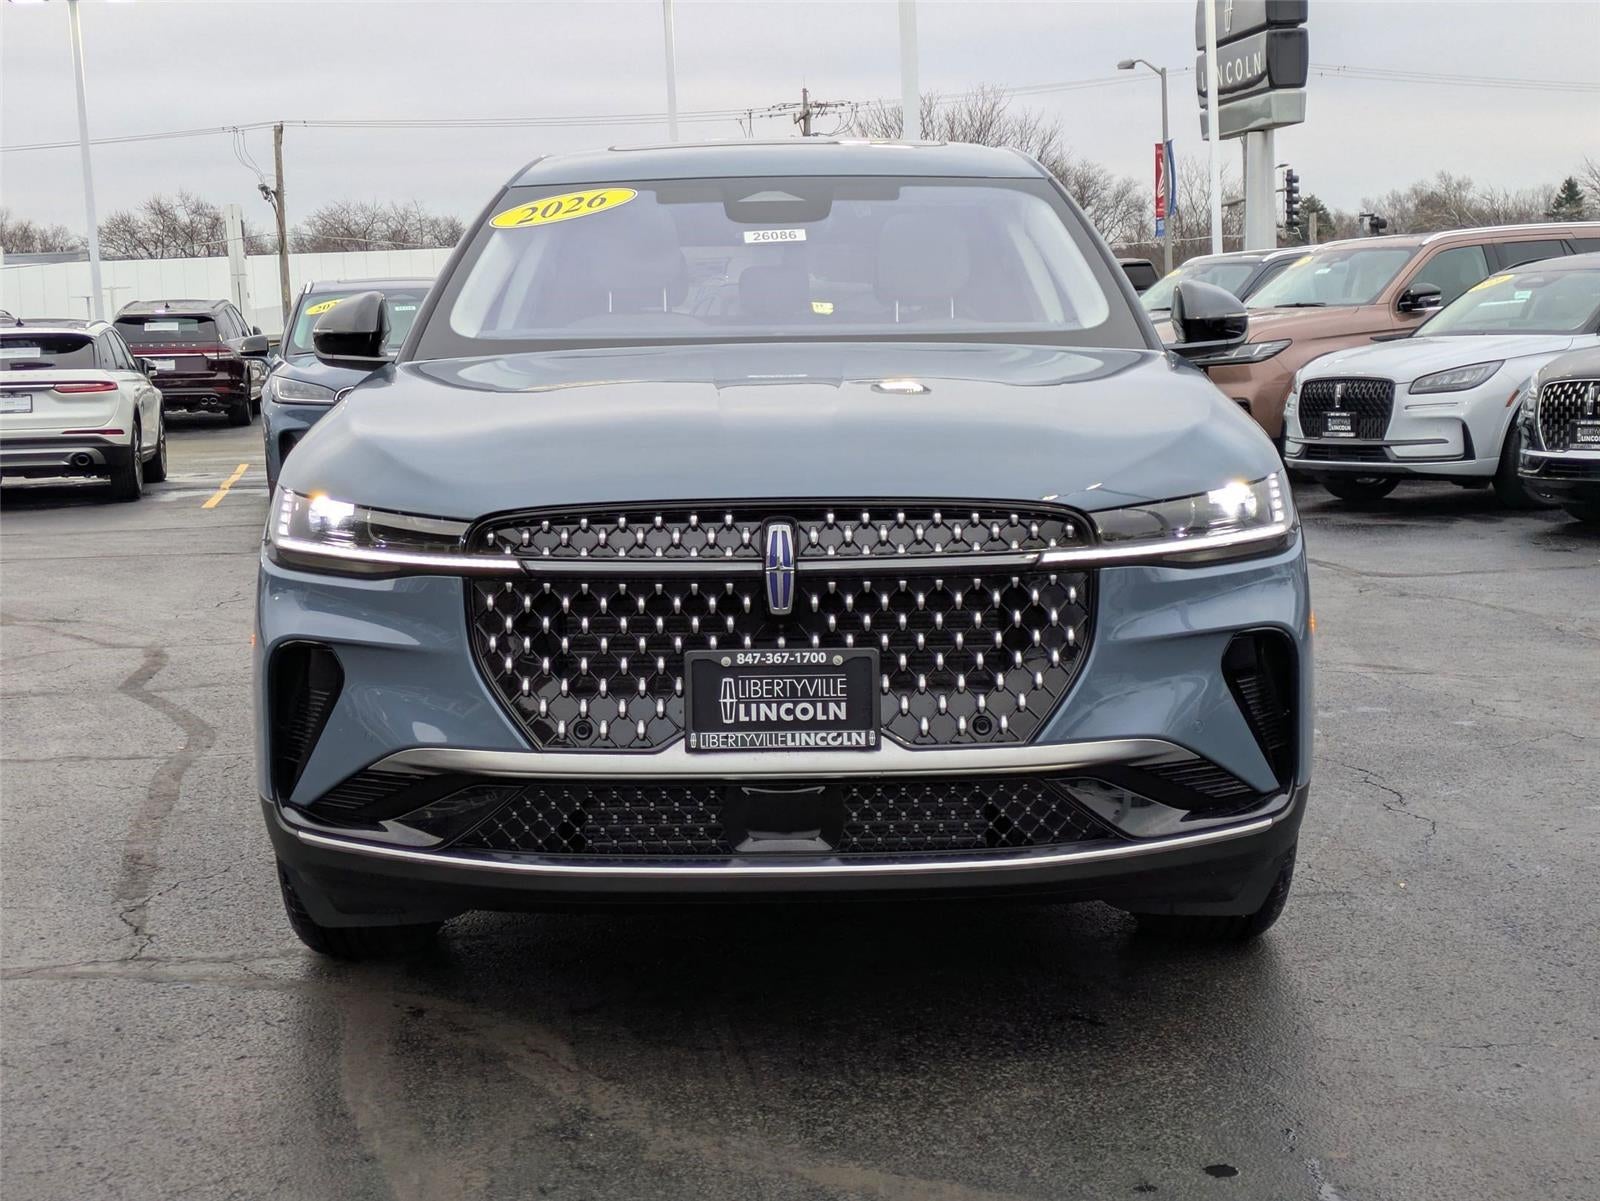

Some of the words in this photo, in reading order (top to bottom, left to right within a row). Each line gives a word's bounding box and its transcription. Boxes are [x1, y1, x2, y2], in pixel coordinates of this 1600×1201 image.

[1201, 51, 1262, 92] LNCOLN
[516, 191, 608, 225] 2026
[752, 230, 798, 241] 26086
[736, 652, 827, 664] 847-367-1700
[738, 678, 847, 698] LIBERTYVILLE
[738, 702, 847, 722] LINCOLN
